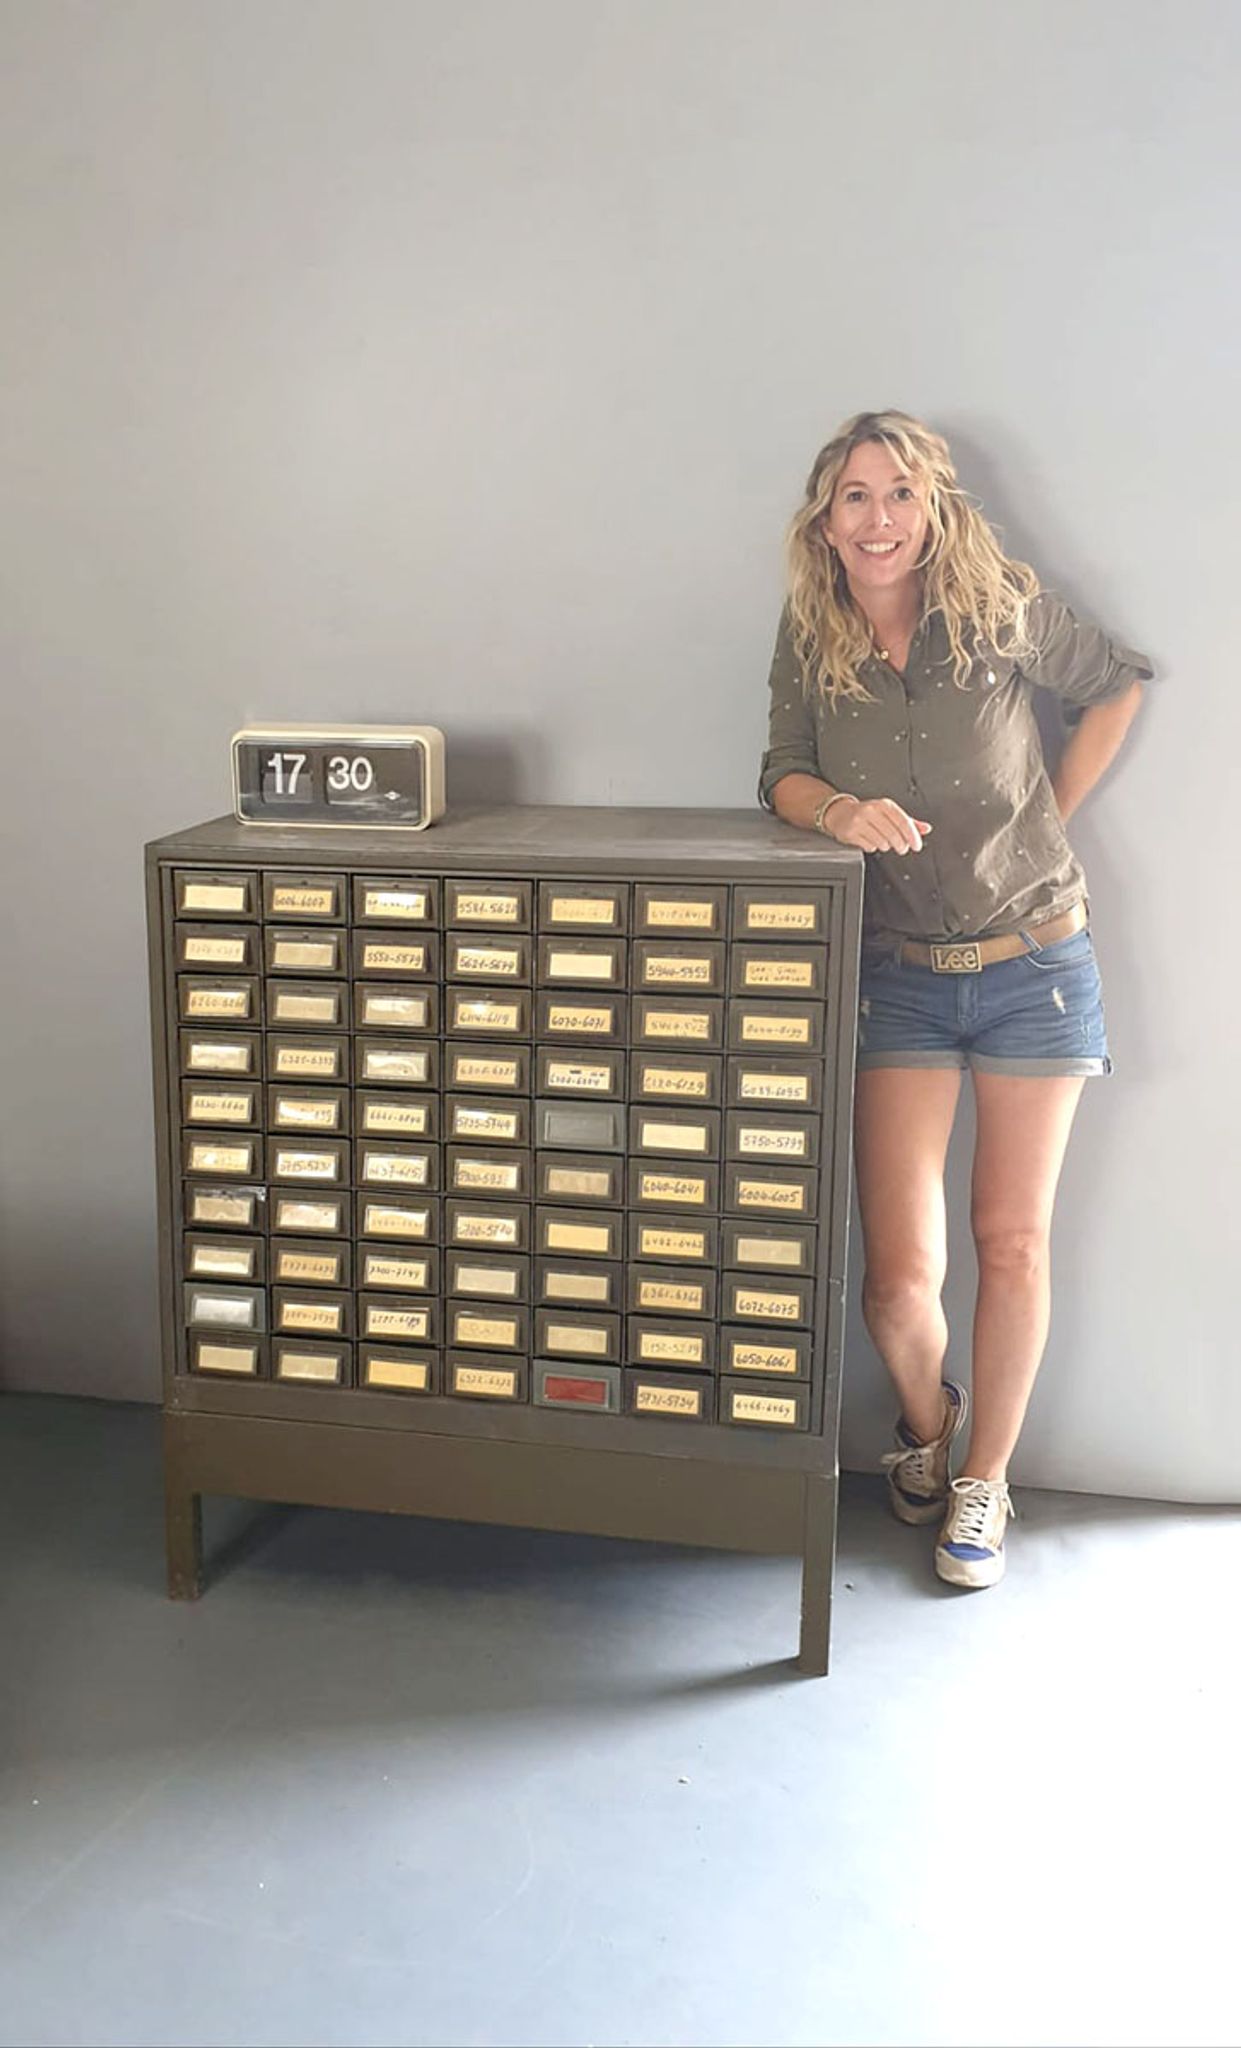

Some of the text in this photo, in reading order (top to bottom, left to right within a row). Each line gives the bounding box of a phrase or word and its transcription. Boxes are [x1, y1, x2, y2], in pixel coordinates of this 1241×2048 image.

[267, 752, 374, 795] 17 30
[934, 948, 979, 970] Lee
[551, 1014, 606, 1029] 6070-6071
[737, 1298, 798, 1316] 6072-6075
